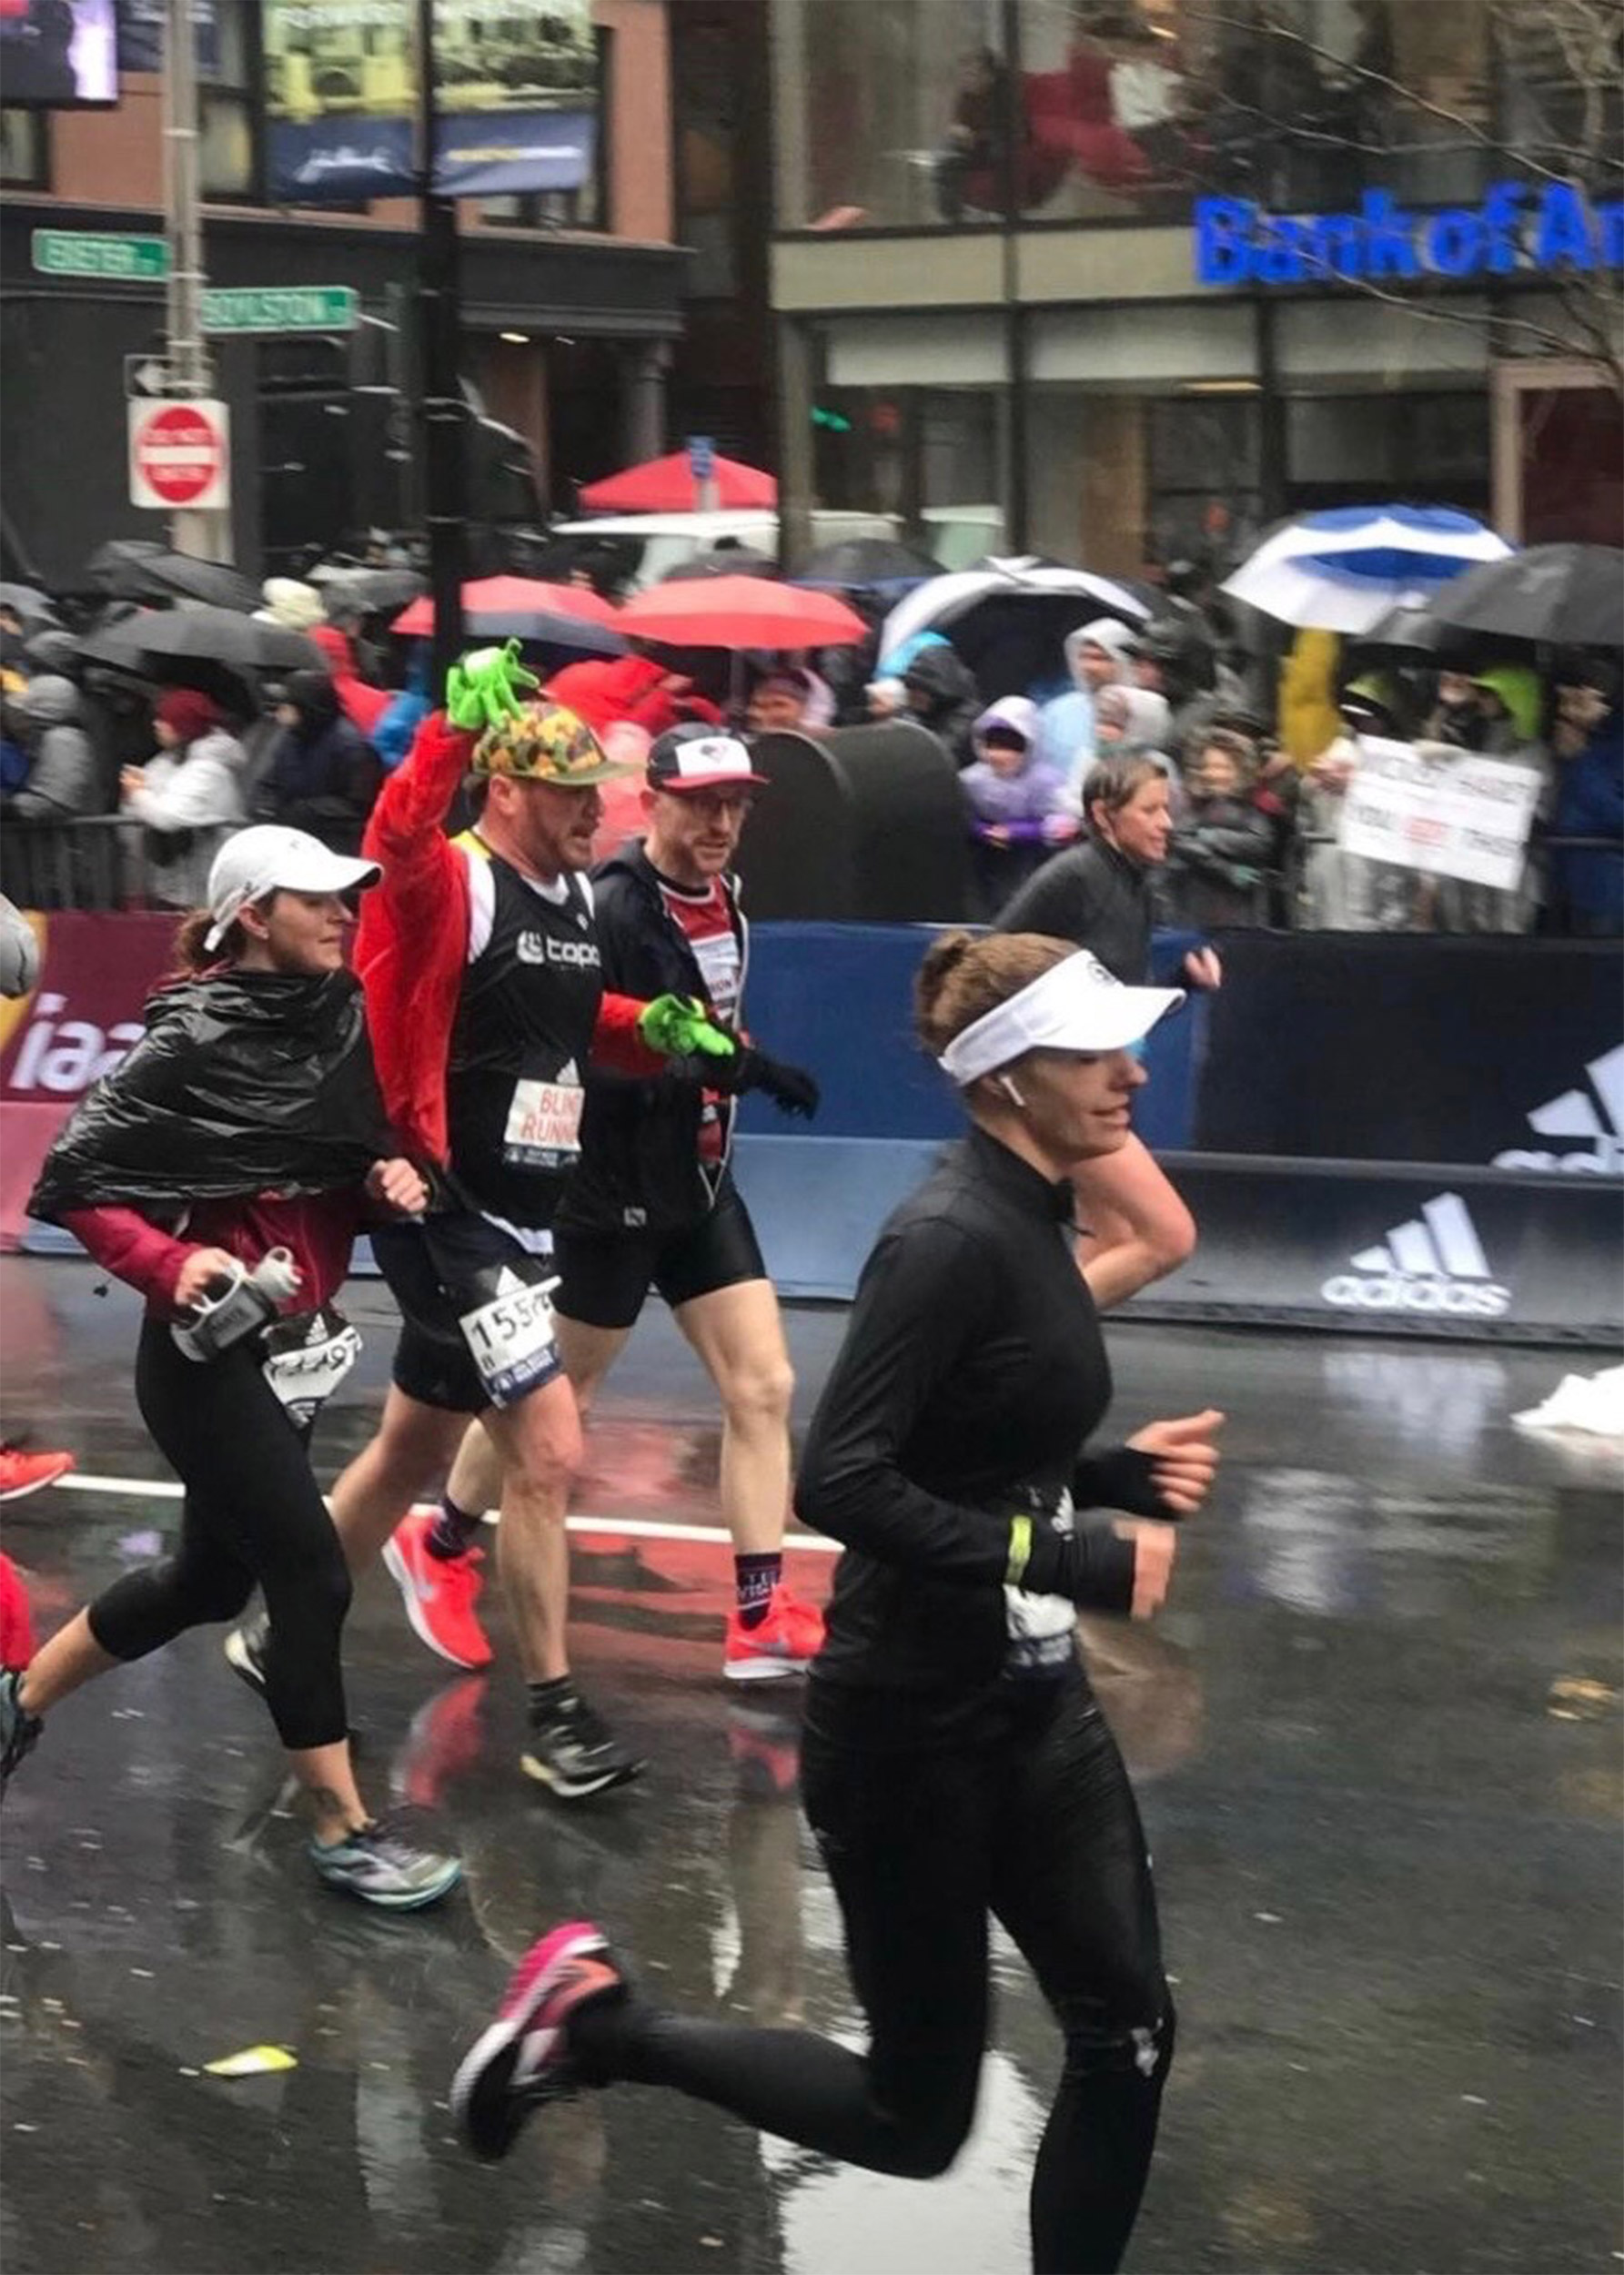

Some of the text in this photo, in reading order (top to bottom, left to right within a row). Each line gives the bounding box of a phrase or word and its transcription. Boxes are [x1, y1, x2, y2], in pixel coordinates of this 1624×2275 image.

[1195, 189, 1416, 288] Bank
[1429, 182, 1528, 277] of
[1320, 1275, 1513, 1316] adidas
